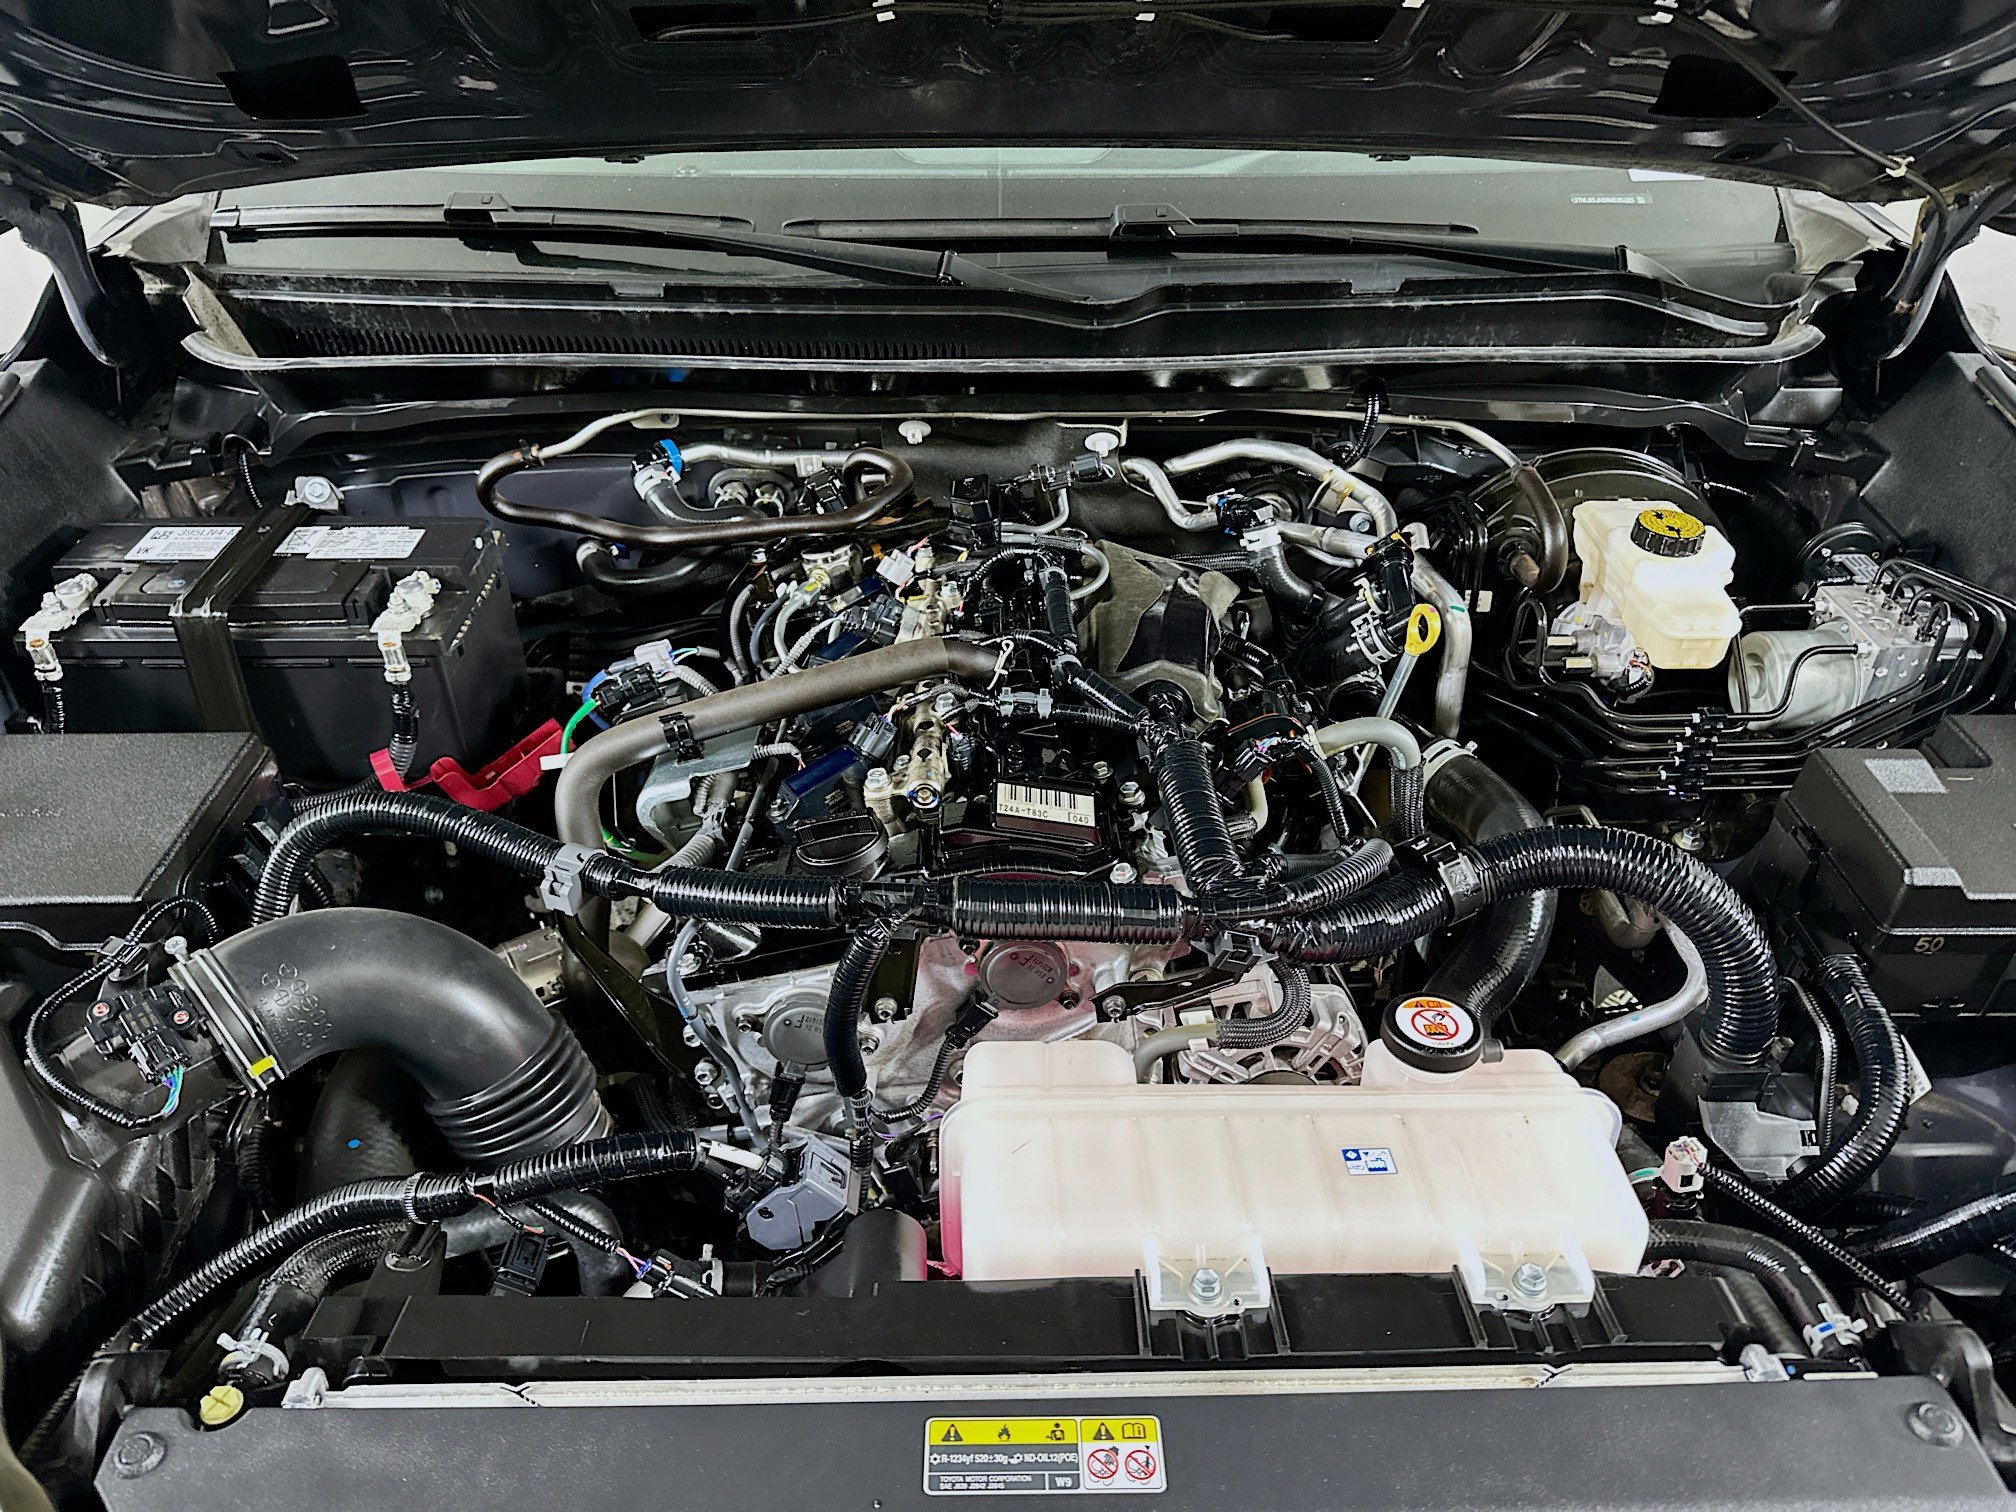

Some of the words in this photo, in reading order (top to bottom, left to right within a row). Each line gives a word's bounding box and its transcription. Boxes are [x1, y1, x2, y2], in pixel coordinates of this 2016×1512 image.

[1913, 936, 1945, 953] 50
[940, 1453, 974, 1465] R-1234yf
[974, 1453, 1009, 1465] 520±30g
[939, 1475, 964, 1483] TOYOTA
[965, 1475, 988, 1483] MOTOR
[1054, 1476, 1073, 1488] W9
[939, 1482, 953, 1490] SAE
